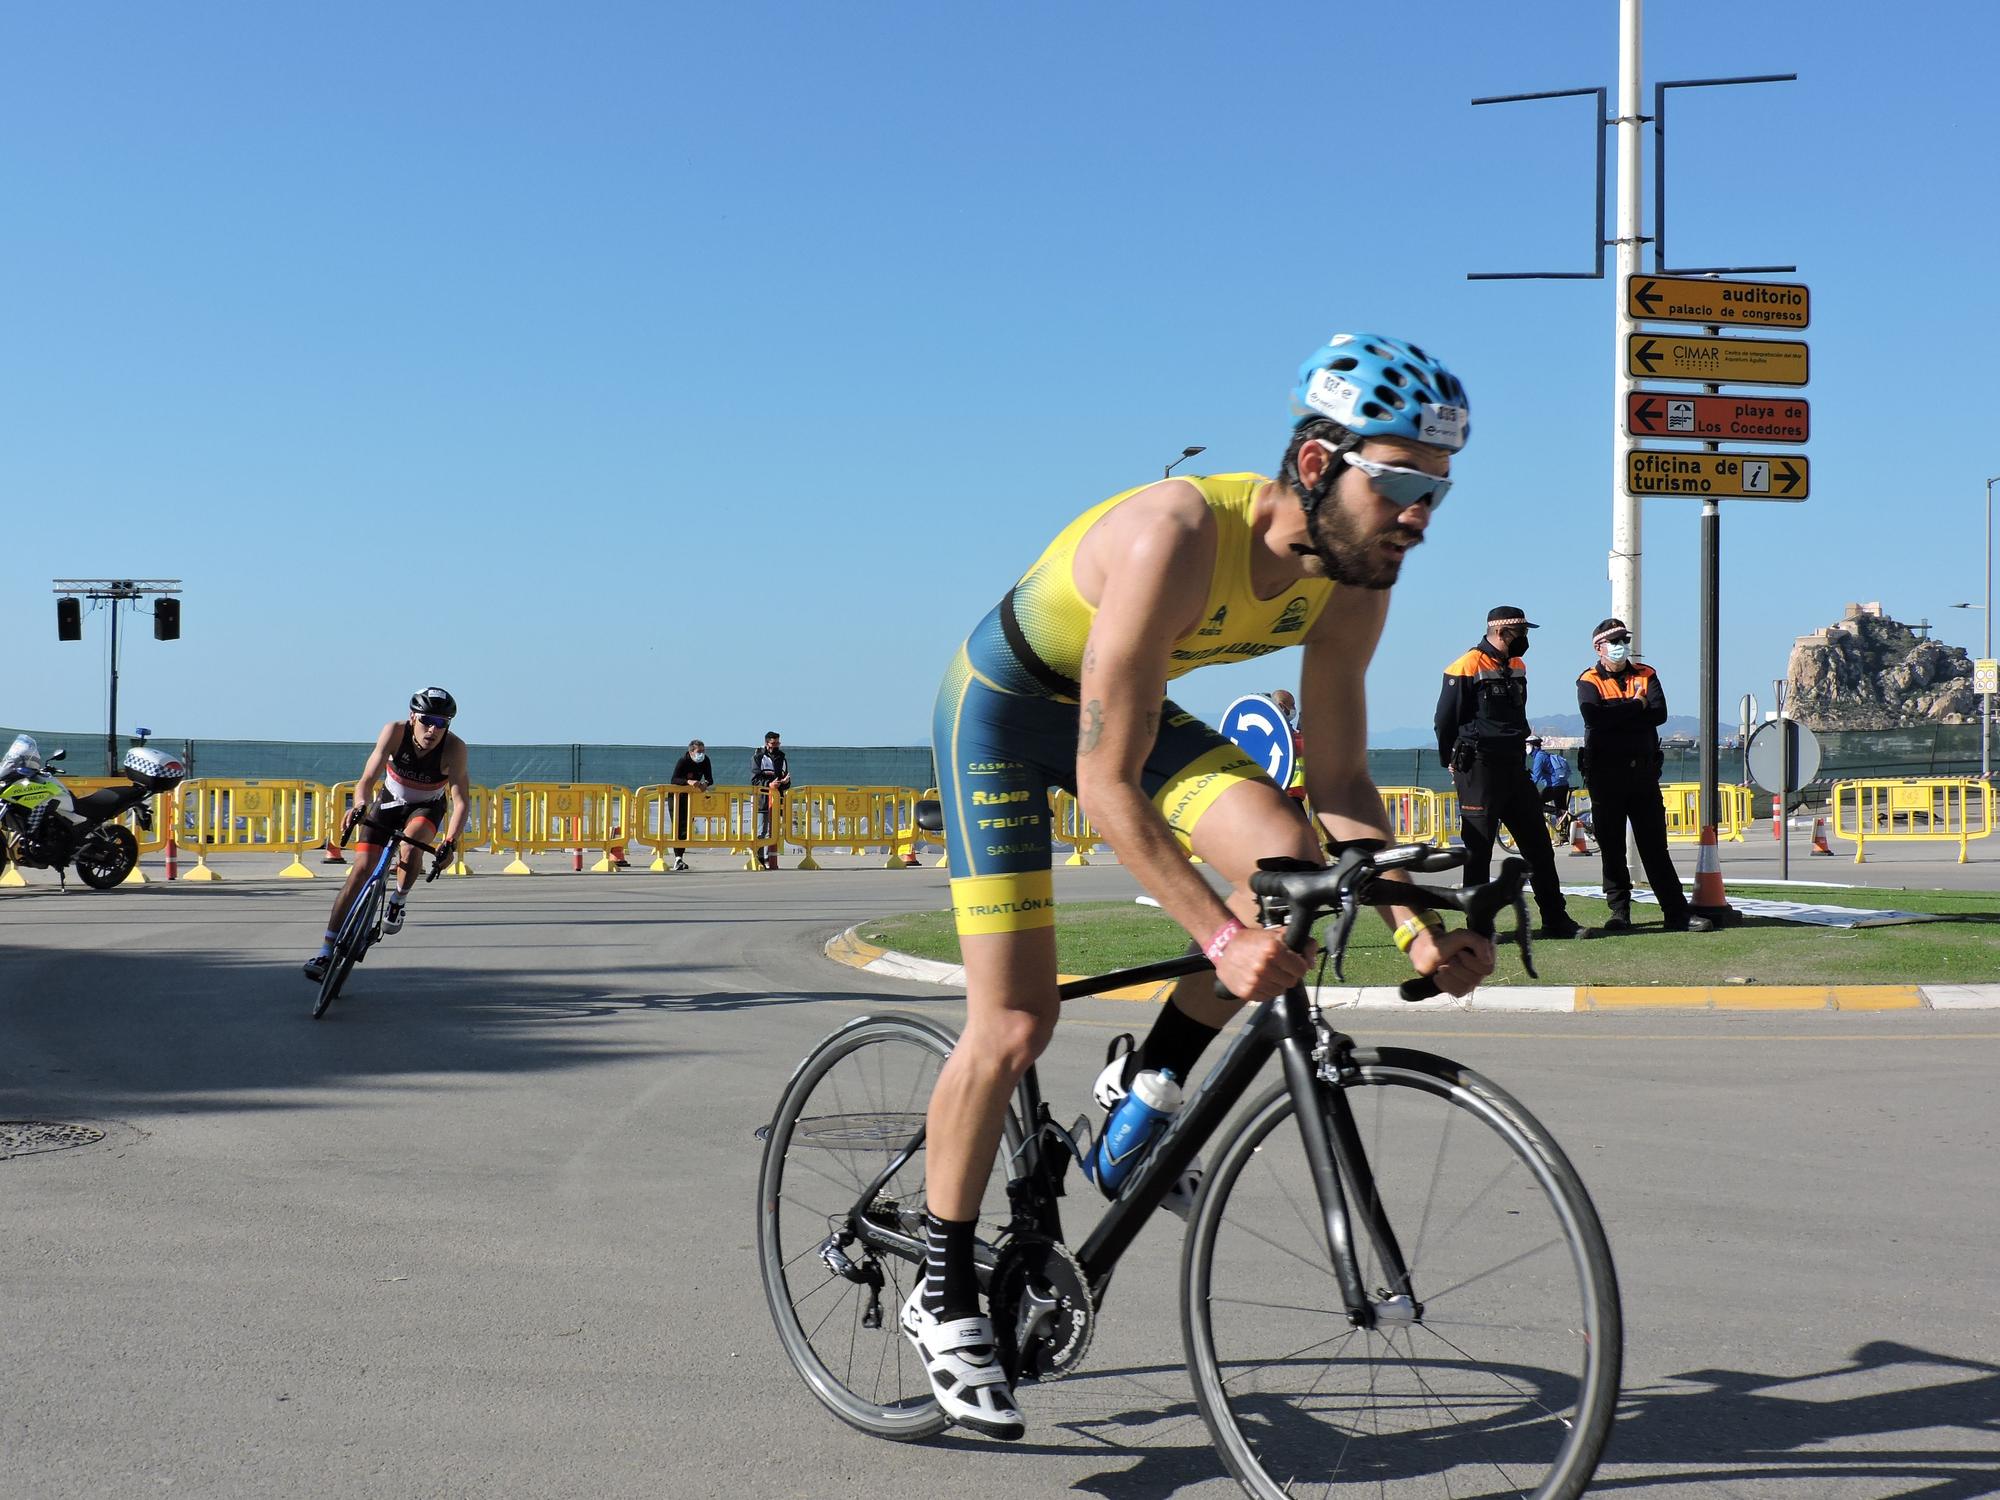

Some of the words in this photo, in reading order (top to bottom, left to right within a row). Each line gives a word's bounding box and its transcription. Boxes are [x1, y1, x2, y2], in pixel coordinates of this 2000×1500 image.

[1722, 288, 1802, 306] auditorio
[1668, 303, 1713, 317] palacio
[1720, 307, 1735, 317] de
[1742, 309, 1802, 321] congresos
[1673, 345, 1719, 360] CIMAR
[1735, 404, 1775, 418] playa
[1784, 407, 1802, 418] de
[1698, 421, 1721, 432] Los
[1730, 421, 1802, 436] Cocedores
[1634, 455, 1702, 473] oficina
[1715, 459, 1738, 475] de
[1634, 473, 1711, 492] turismo
[967, 898, 1041, 917] TRIATLÓN
[867, 1231, 920, 1256] ORBEA
